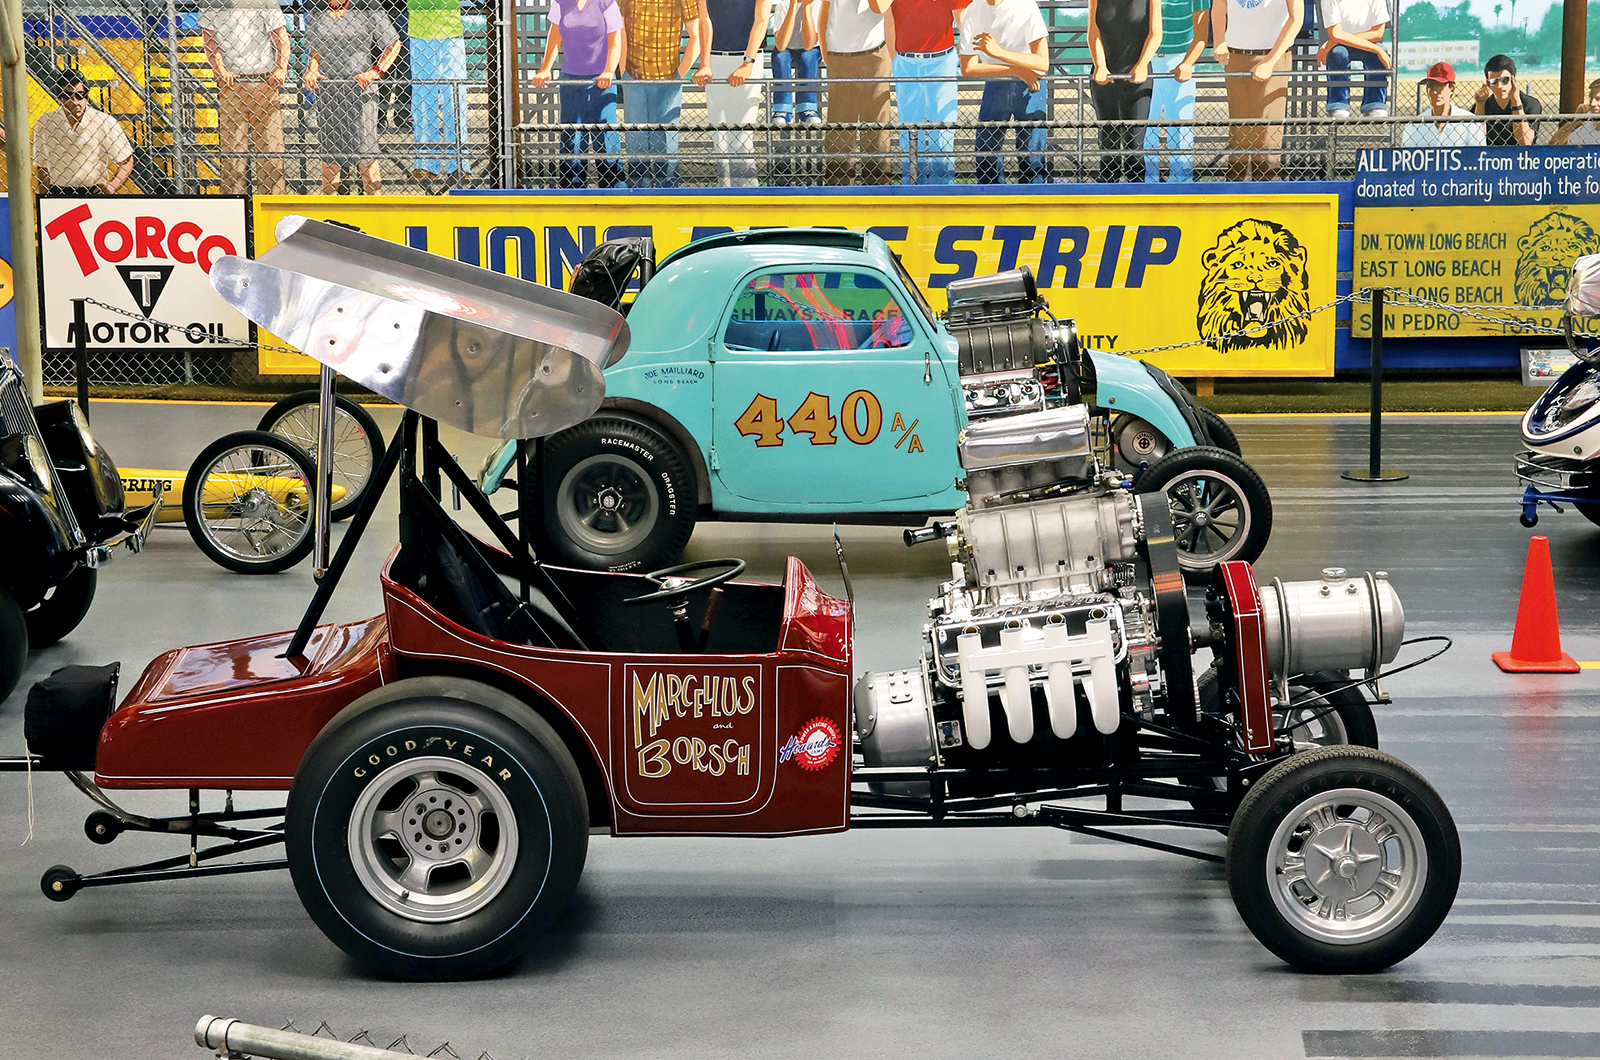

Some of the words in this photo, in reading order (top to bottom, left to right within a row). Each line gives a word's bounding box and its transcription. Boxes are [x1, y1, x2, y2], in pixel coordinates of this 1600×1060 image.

[1357, 149, 1388, 172] ALL
[1517, 151, 1540, 170] the
[1357, 178, 1415, 198] donated
[1421, 179, 1438, 197] to
[1441, 178, 1493, 202] charity
[1498, 176, 1552, 201] through
[1557, 175, 1582, 195] the
[45, 203, 237, 277] TORCO
[1361, 233, 1383, 250] DN.
[1387, 233, 1425, 250] TOWN
[1430, 233, 1462, 250] LONG
[1466, 232, 1507, 249] BEACH
[928, 225, 1182, 289] STRIP
[1360, 261, 1398, 277] EAST
[1406, 261, 1446, 277] LONG
[1452, 260, 1501, 276] BEACH
[1360, 287, 1401, 303] WST
[1408, 287, 1449, 303] LONG
[1455, 287, 1503, 303] BEACH
[185, 322, 224, 344] OIL
[1360, 313, 1395, 331] SN
[1402, 313, 1460, 331] PEDRO
[645, 369, 658, 380] JOE
[661, 367, 704, 379] MAILLIARD
[734, 389, 882, 447] 440
[601, 437, 655, 462] RACEMASTER
[661, 472, 677, 516] DRAGSTER
[632, 669, 755, 749] MARCELLUS
[712, 722, 735, 730] and
[638, 736, 751, 778] BORSCH
